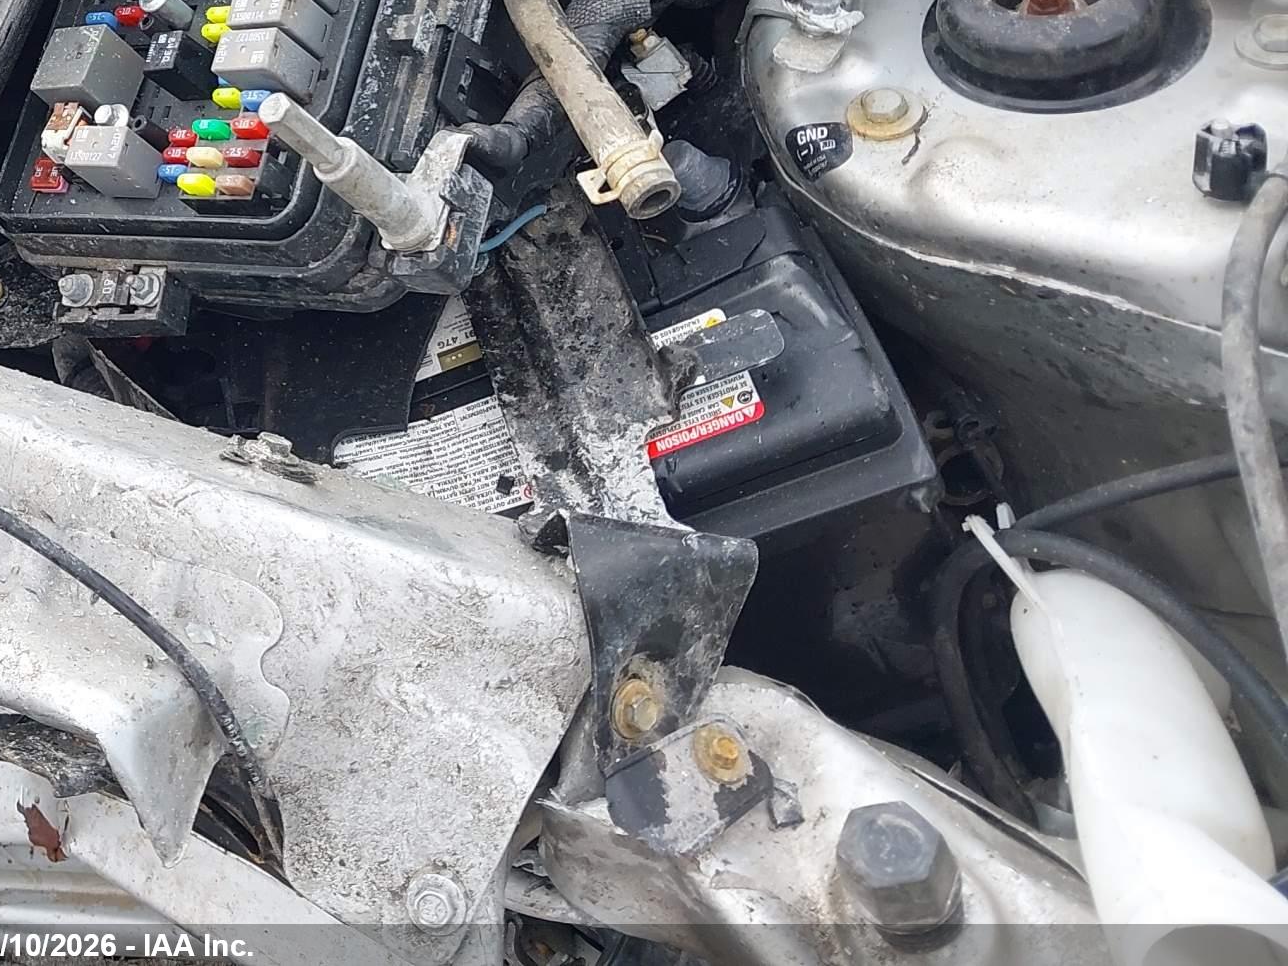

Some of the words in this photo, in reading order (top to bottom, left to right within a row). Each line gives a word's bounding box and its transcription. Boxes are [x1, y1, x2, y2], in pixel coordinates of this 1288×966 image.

[796, 126, 828, 145] GND
[435, 334, 459, 350] 47G
[653, 409, 745, 452] DANGER/POISON
